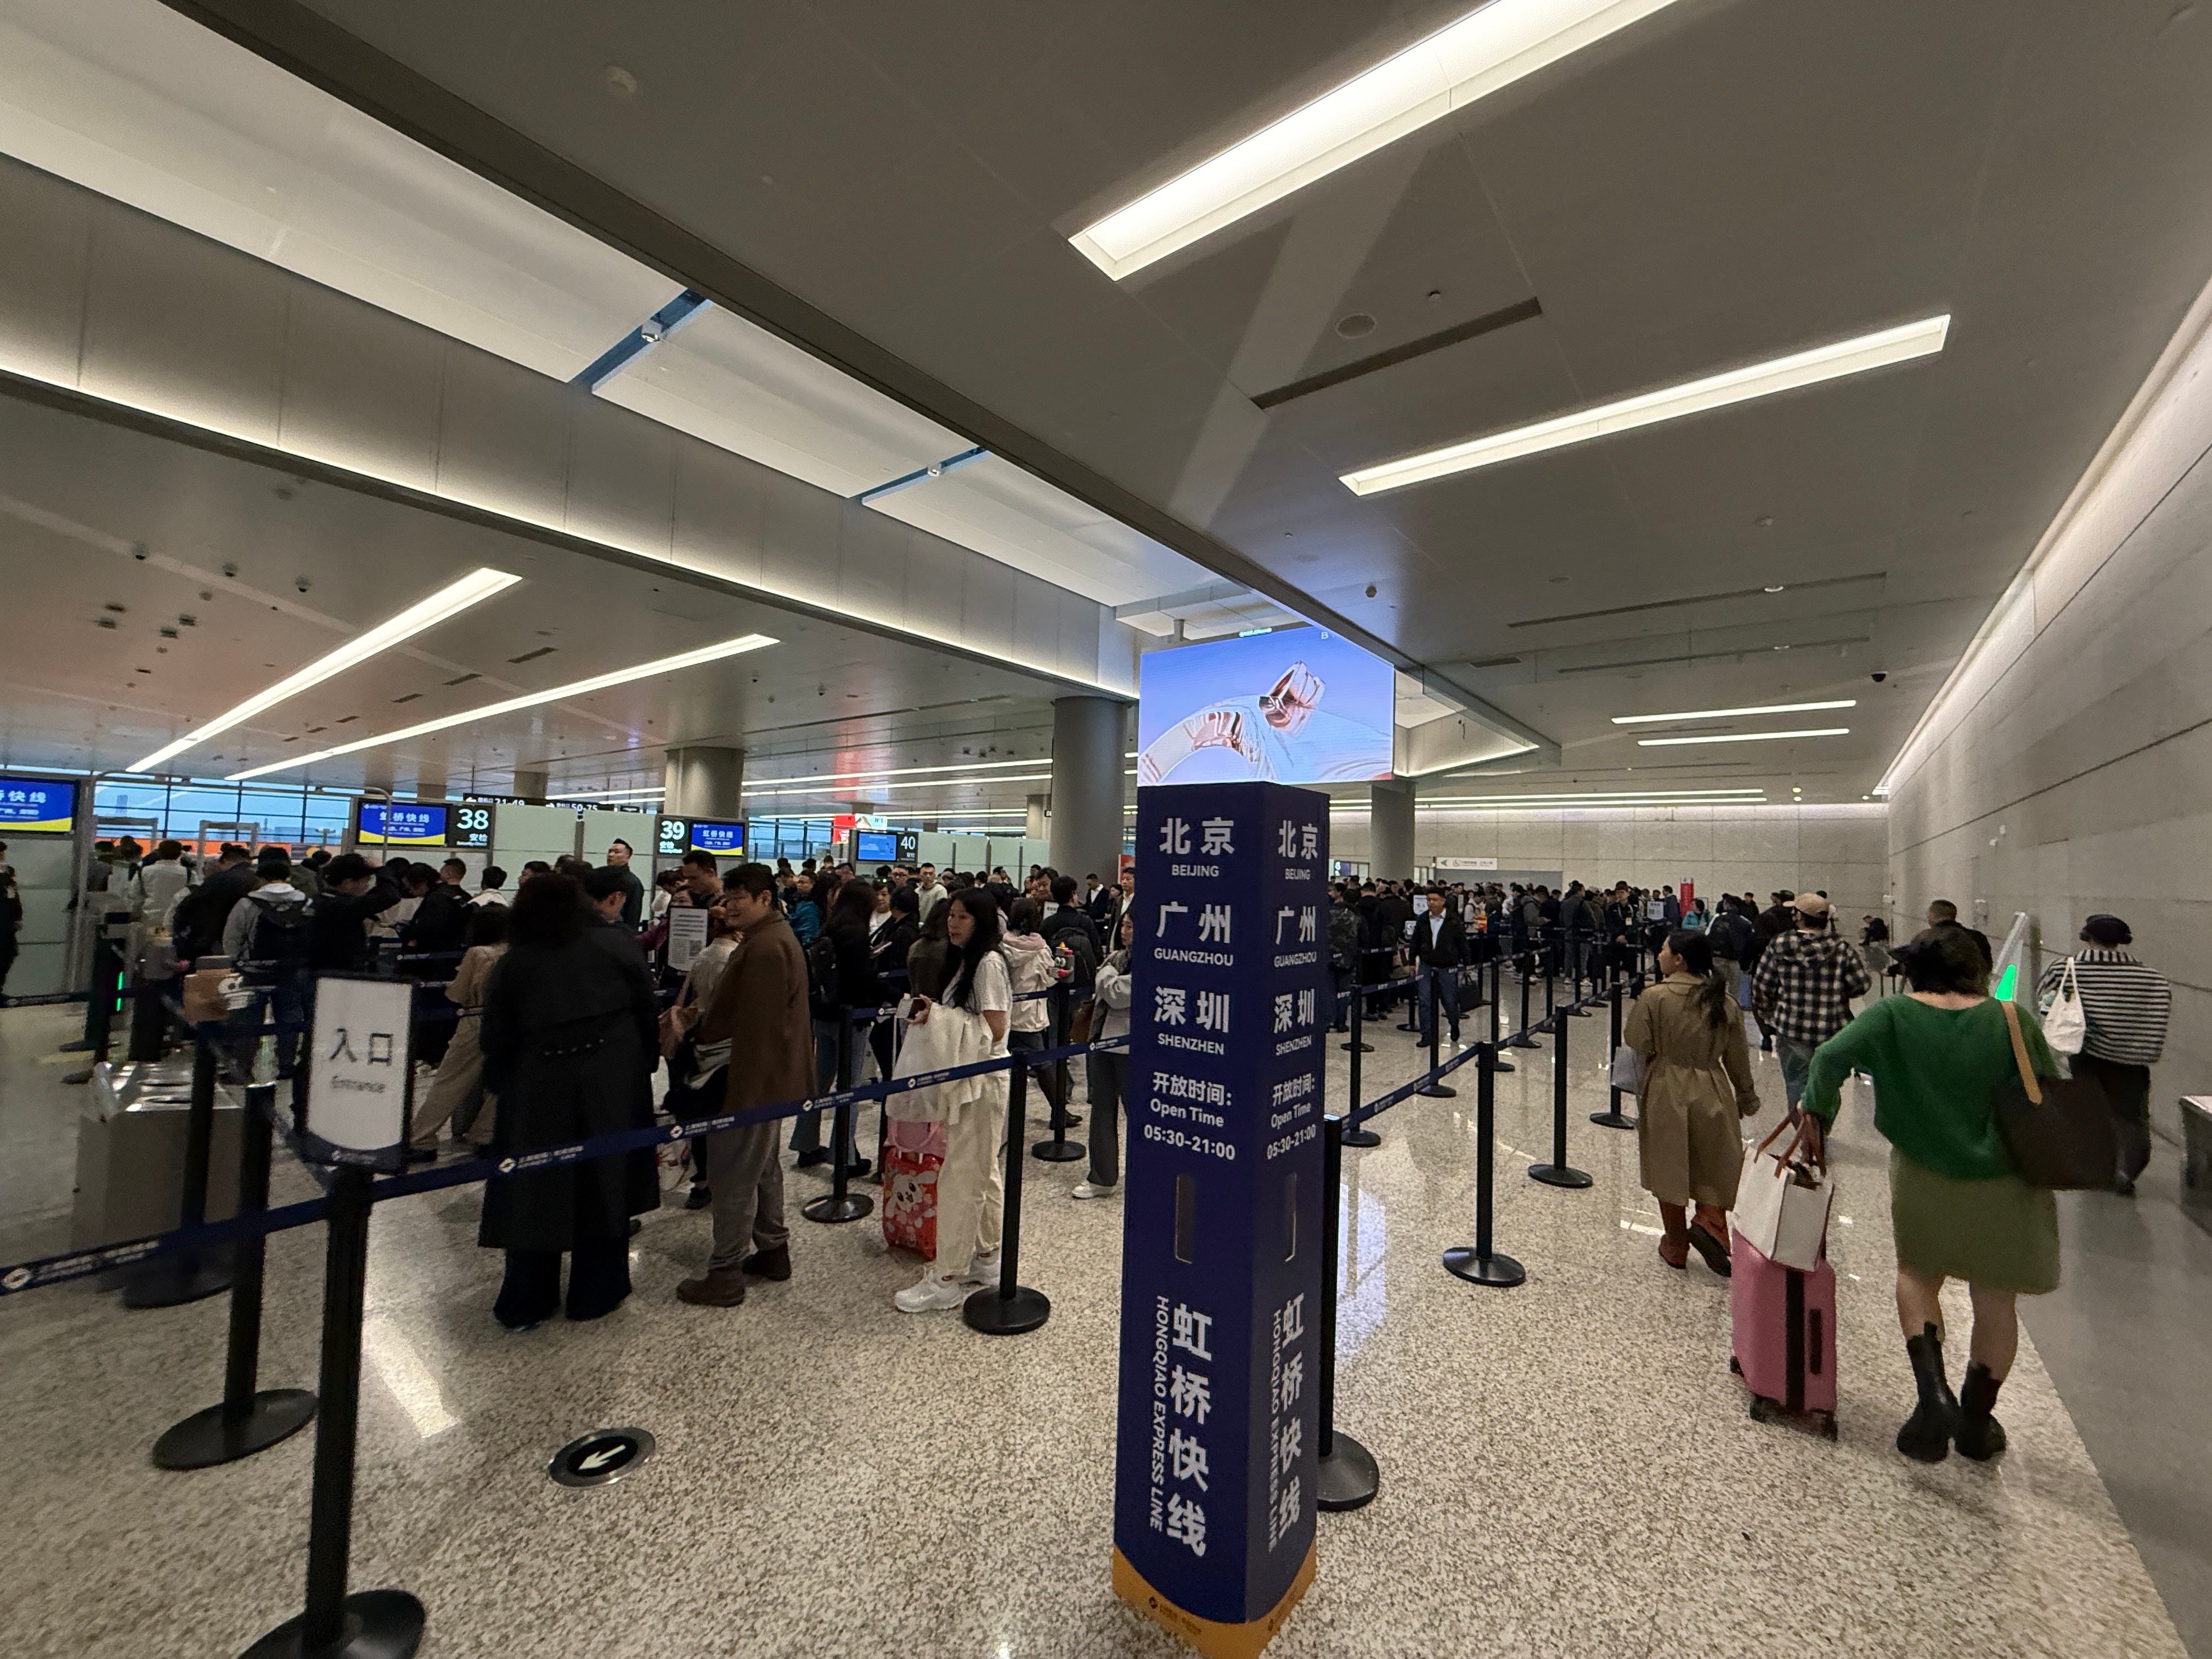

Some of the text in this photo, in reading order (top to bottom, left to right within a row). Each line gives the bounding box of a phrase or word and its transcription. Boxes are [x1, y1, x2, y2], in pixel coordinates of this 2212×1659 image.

[0, 789, 46, 803] 快线
[457, 809, 489, 830] 38
[660, 821, 685, 840] 39
[1159, 817, 1234, 855] 北京
[900, 836, 916, 850] 40
[1278, 820, 1318, 860] 北京
[1172, 865, 1220, 877] BEIJING
[1285, 868, 1311, 880] BEIJING
[1156, 901, 1231, 944] 广州
[1276, 906, 1316, 945] 广州
[1154, 947, 1234, 967] GUANGZHOU
[1274, 951, 1317, 968] GUANGZHOU
[1154, 986, 1229, 1033] 深圳
[1273, 988, 1314, 1034] 深圳
[329, 1028, 393, 1066] 入口
[1158, 1032, 1224, 1055] SHENZHEN
[1276, 1035, 1312, 1056] SHENZHEN
[1153, 1071, 1232, 1106] 开放时间：
[1150, 1098, 1224, 1127] Open Time
[1271, 1102, 1311, 1130] Open Time
[1144, 1124, 1235, 1160] 05:30-21:00
[1267, 1124, 1316, 1160] 05:30-21:00
[1271, 1309, 1282, 1414] HONGQIAO
[1150, 1295, 1169, 1532] HONGQIAO EXPRESS LINE
[1166, 1302, 1212, 1556] 虹桥快线
[1279, 1292, 1304, 1539] 虹桥快线
